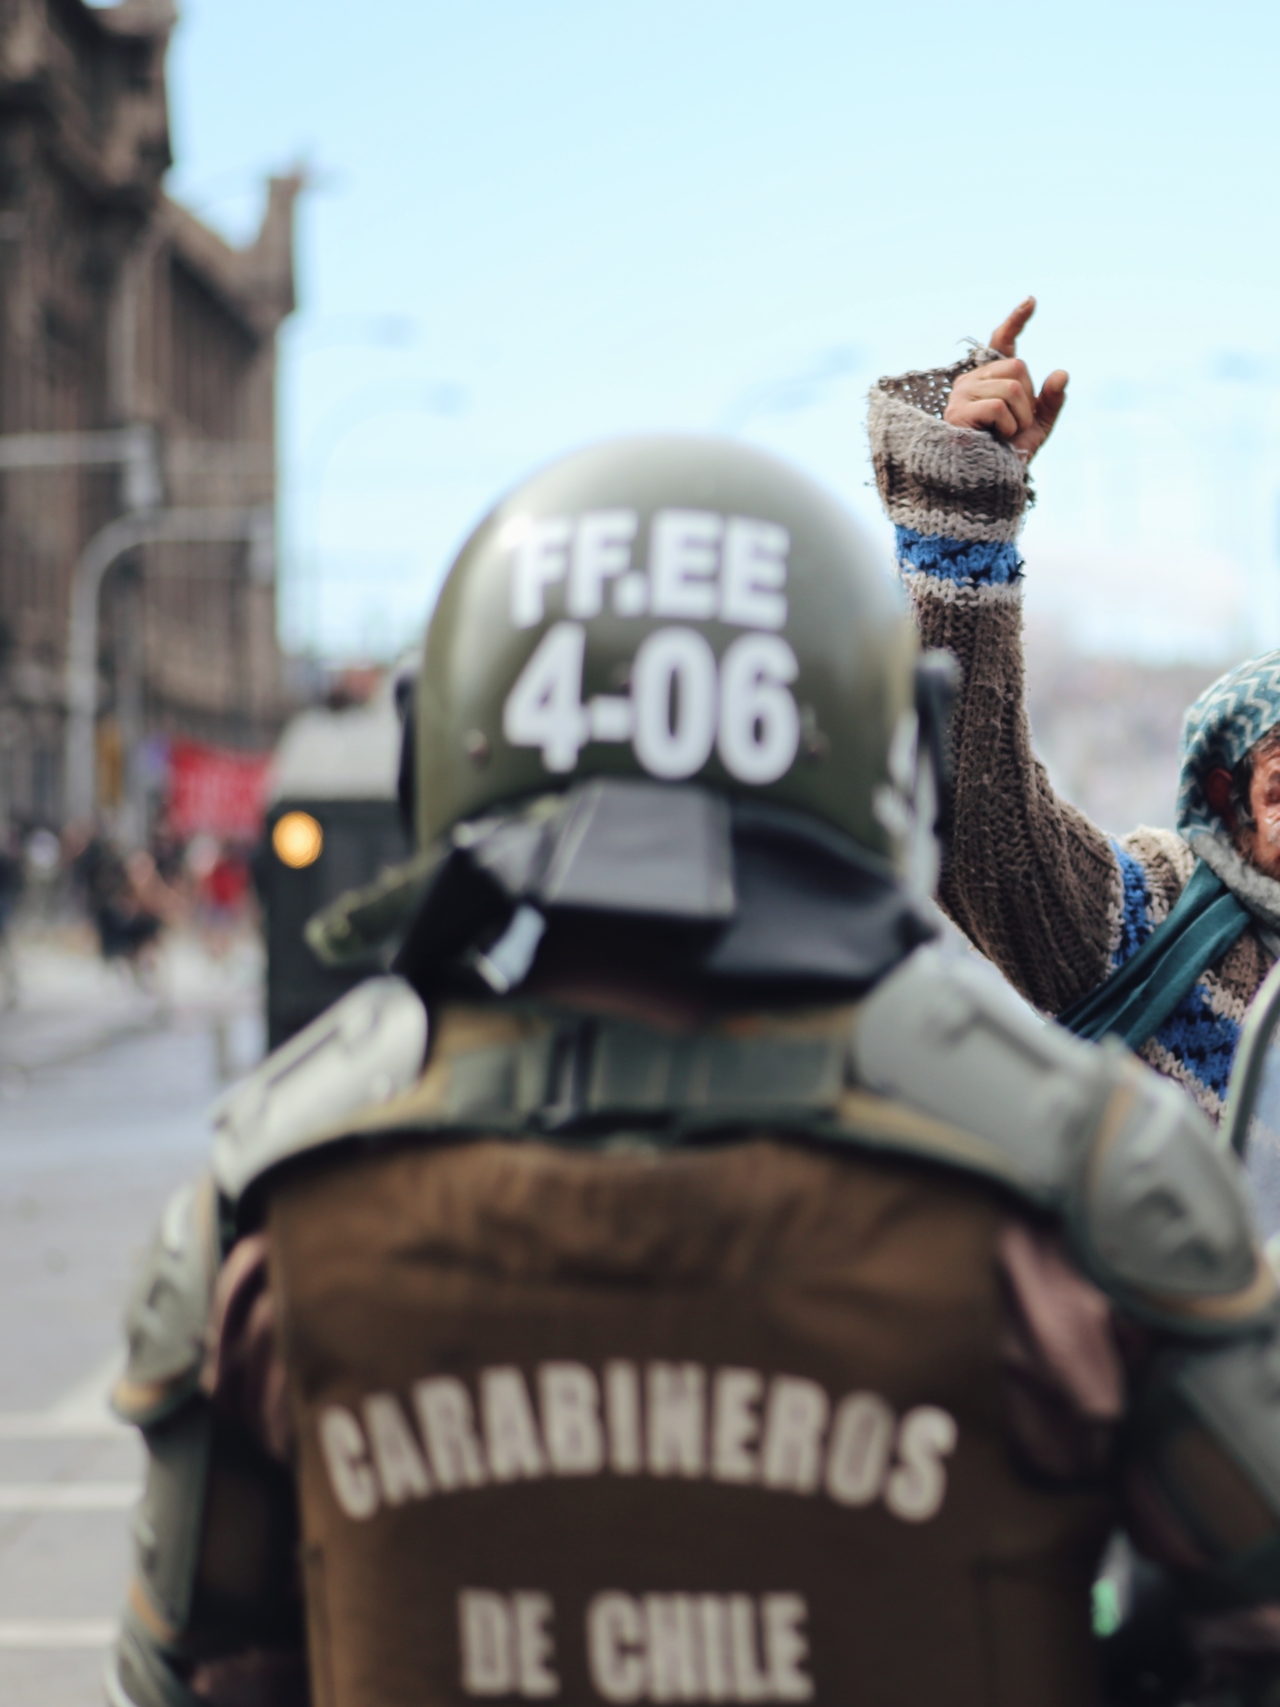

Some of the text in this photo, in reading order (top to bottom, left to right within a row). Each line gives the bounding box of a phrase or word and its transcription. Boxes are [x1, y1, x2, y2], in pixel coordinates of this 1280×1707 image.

[508, 508, 791, 630] FF.EE
[503, 621, 801, 786] 4-06
[319, 1359, 957, 1522] CARABINEROS
[458, 1587, 814, 1704] DE CHILE
